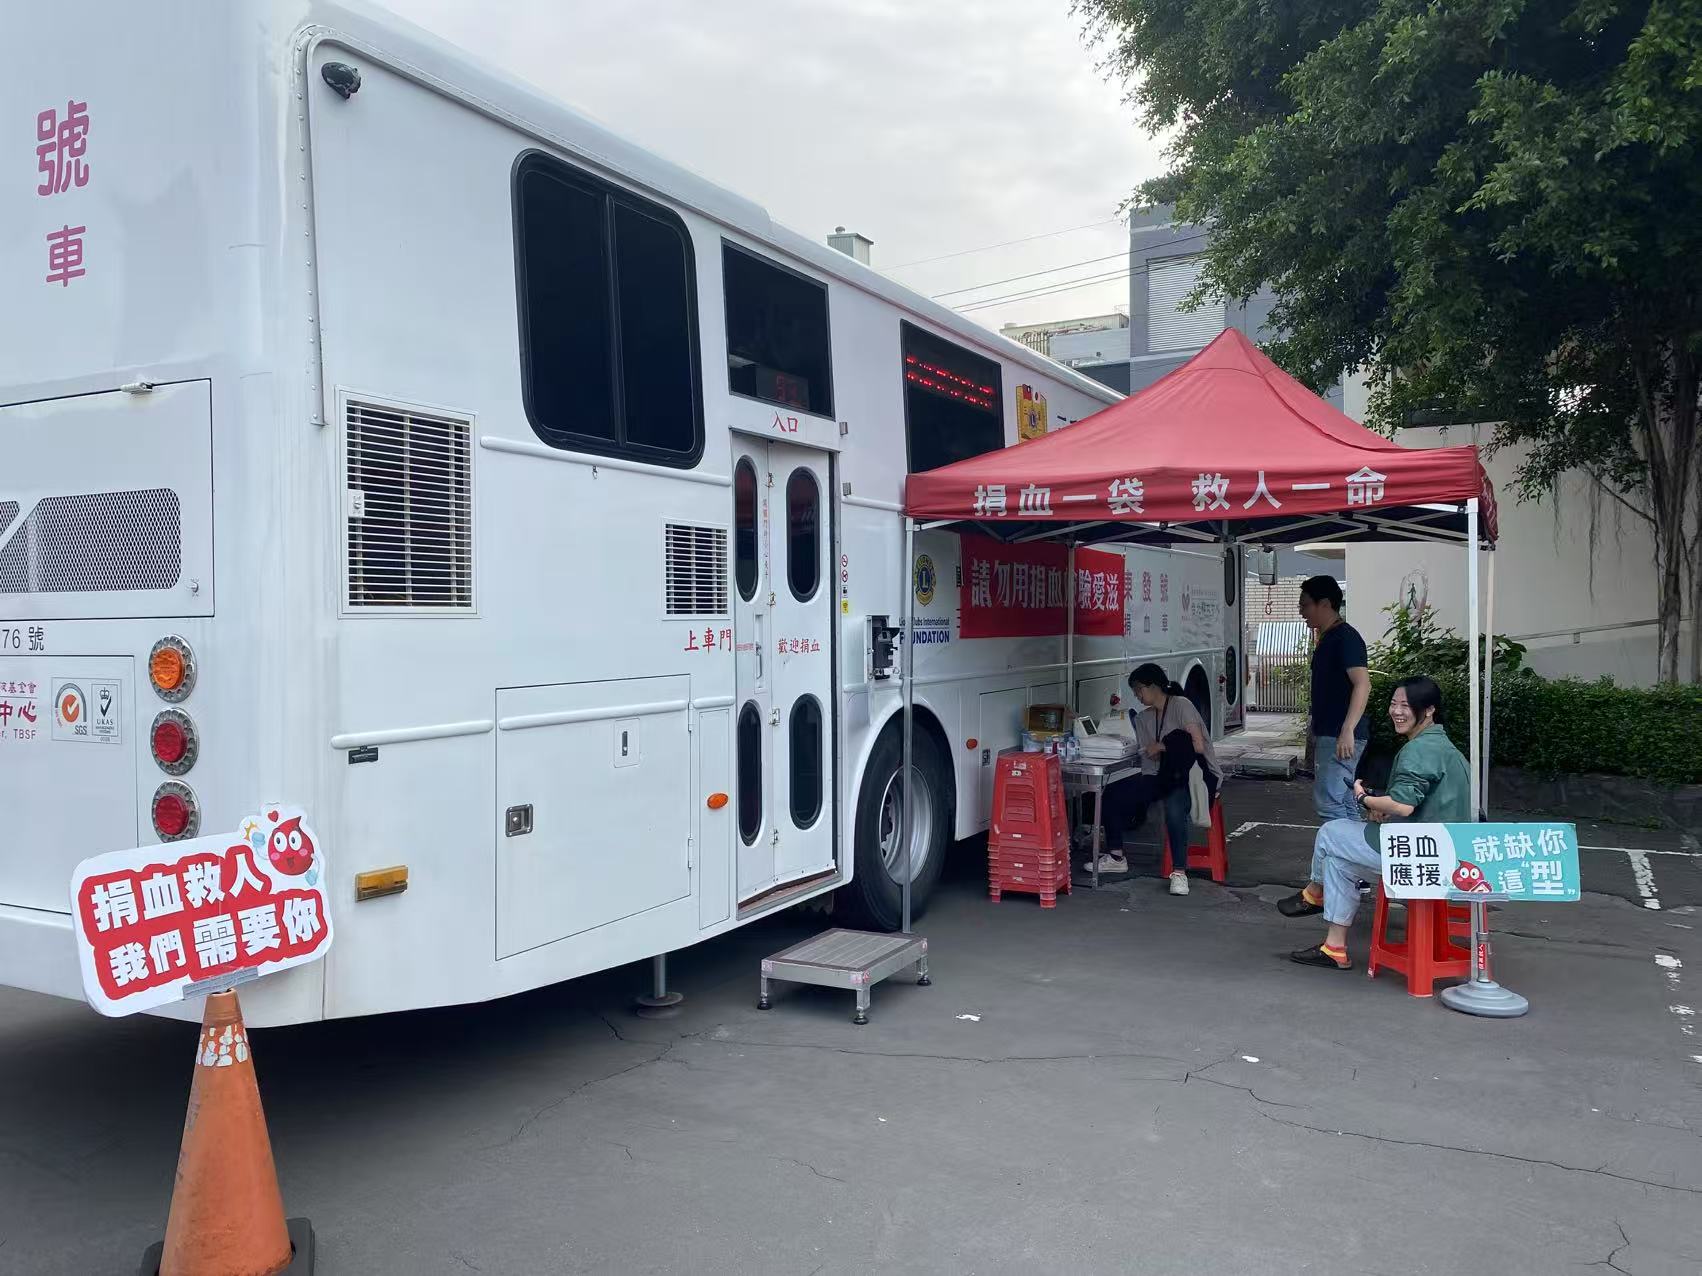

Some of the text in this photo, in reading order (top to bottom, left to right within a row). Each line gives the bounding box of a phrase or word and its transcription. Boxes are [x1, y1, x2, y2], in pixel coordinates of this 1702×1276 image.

[37, 100, 89, 196] 號
[46, 224, 86, 287] 車
[771, 411, 798, 432] 入口
[973, 465, 1388, 516] 捐血一袋 救人一命
[28, 626, 44, 651] 號
[684, 627, 732, 654] 上車門
[778, 637, 820, 654] 歡迎捐血
[899, 630, 950, 645] FUNDATION
[13, 728, 37, 740] TBSF
[74, 724, 88, 736] SGS
[96, 718, 114, 726] UKAS
[1387, 835, 1439, 858] 捐血
[1471, 828, 1569, 864] 就缺你
[1389, 863, 1441, 887] 應援
[91, 853, 265, 933] 捐血救人
[109, 897, 321, 987] 我們需要你
